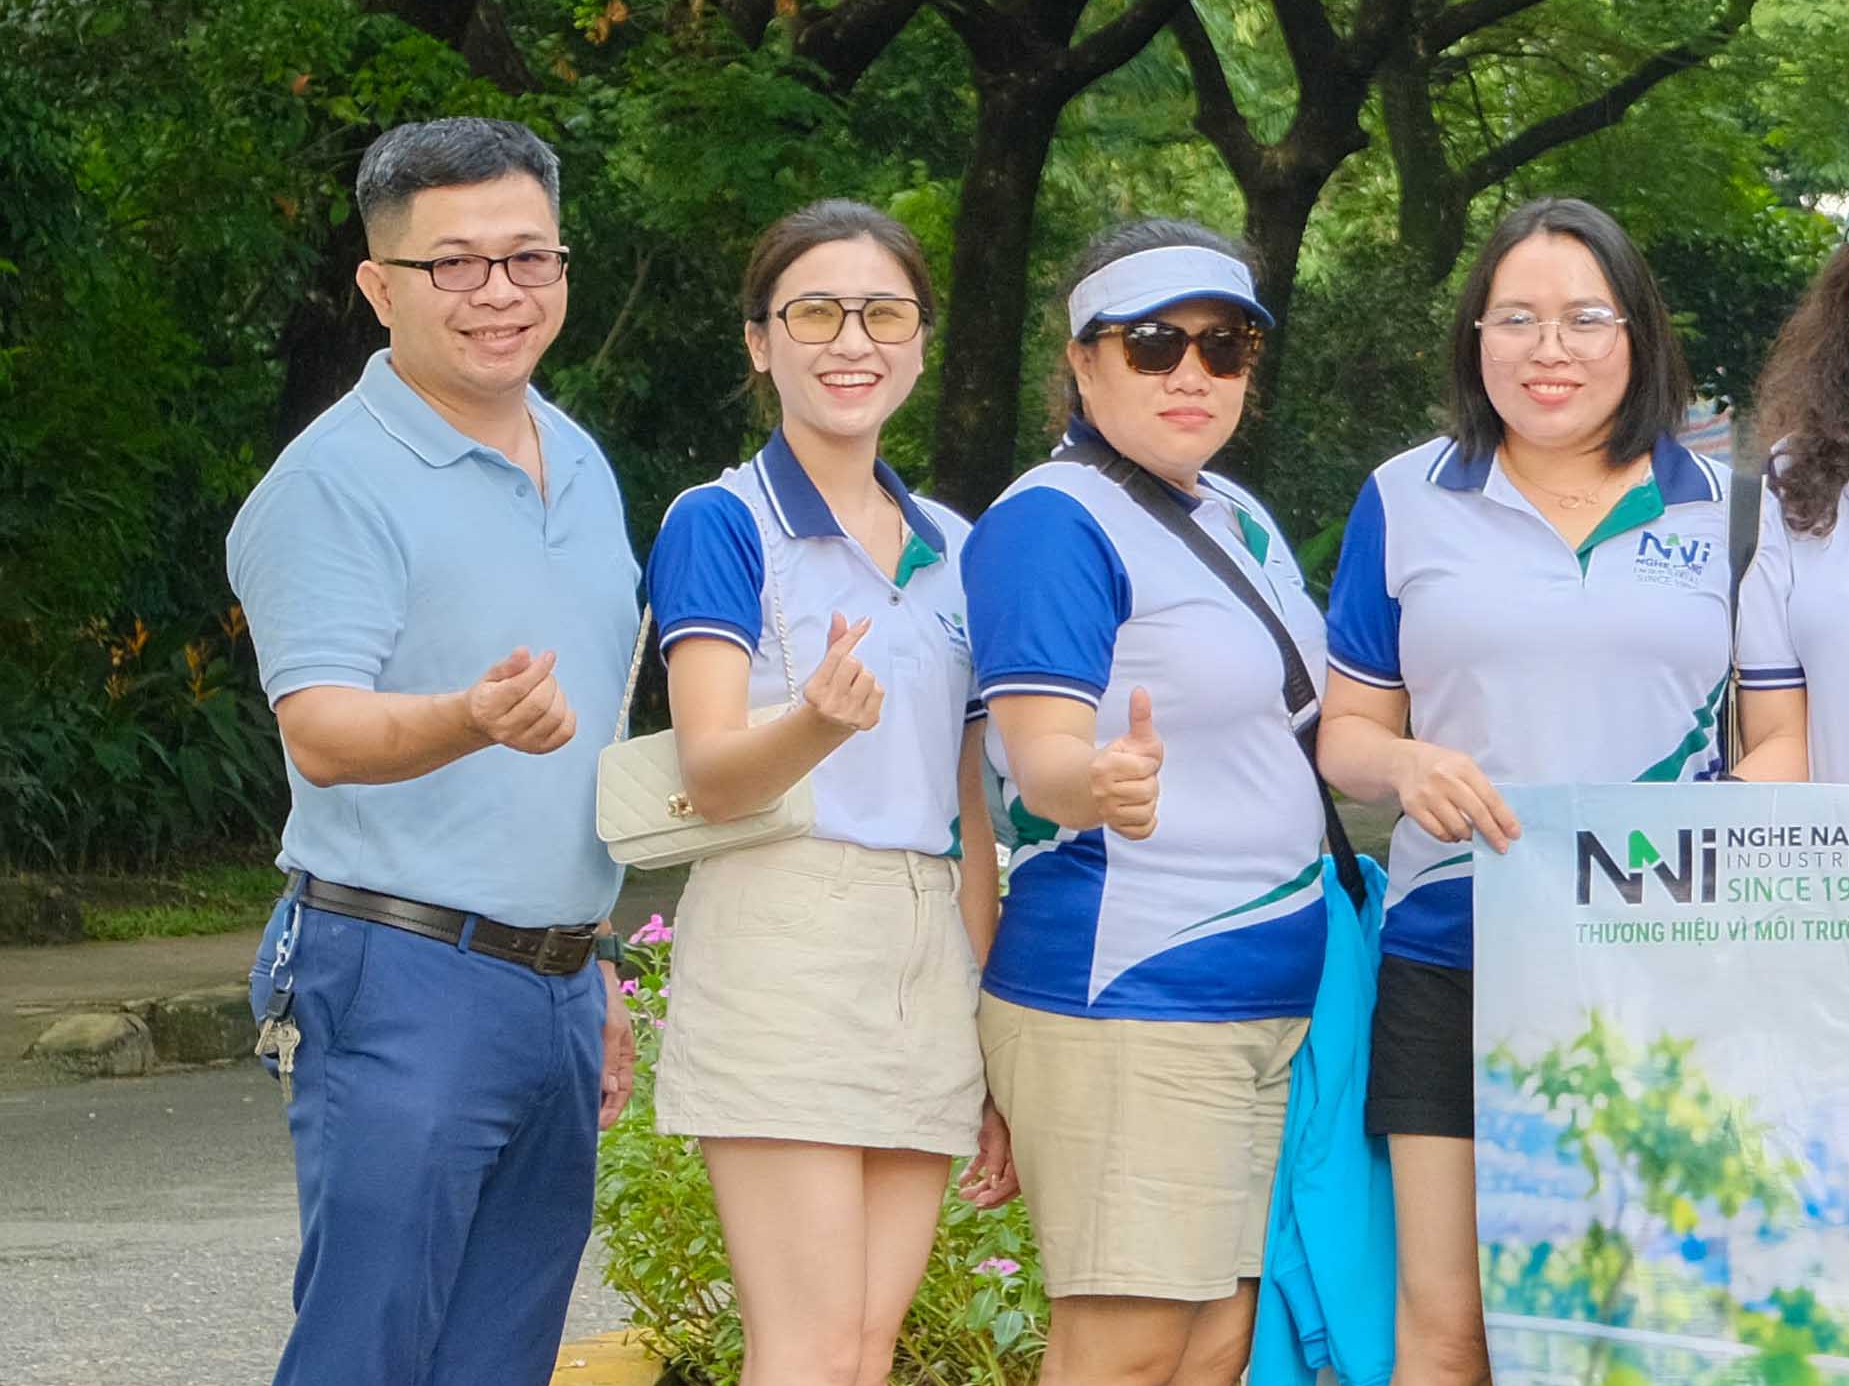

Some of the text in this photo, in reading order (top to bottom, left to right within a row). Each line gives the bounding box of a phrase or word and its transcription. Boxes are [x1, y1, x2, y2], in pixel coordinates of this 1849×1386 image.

[1727, 826, 1802, 847] NGHE
[1727, 876, 1811, 903] SINCE
[1577, 921, 1665, 944] THƯƠNG
[1671, 917, 1720, 947] HIỆU
[1727, 916, 1748, 941] VÌ
[1754, 916, 1795, 941] MÔI
